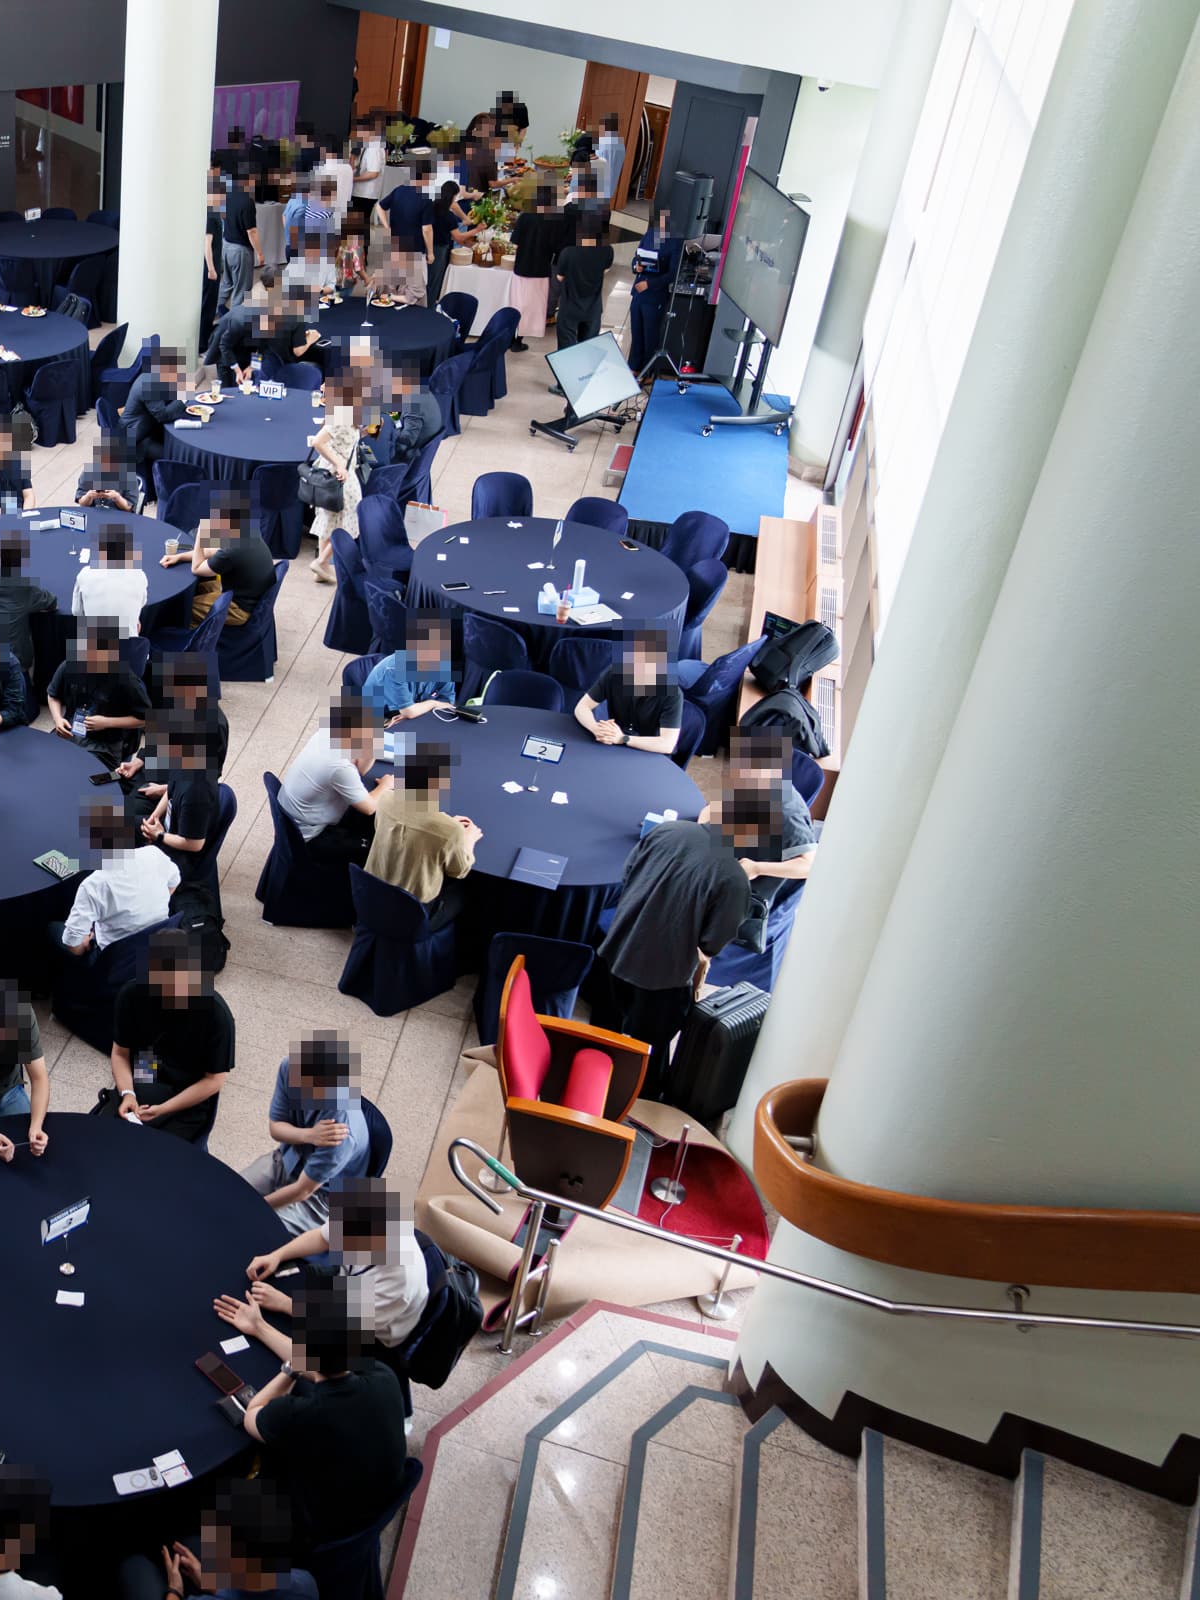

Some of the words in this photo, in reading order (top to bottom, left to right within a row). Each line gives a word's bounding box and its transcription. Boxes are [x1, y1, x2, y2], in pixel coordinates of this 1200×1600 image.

[263, 386, 278, 395] VIP
[69, 516, 76, 526] 5
[538, 745, 548, 756] 2
